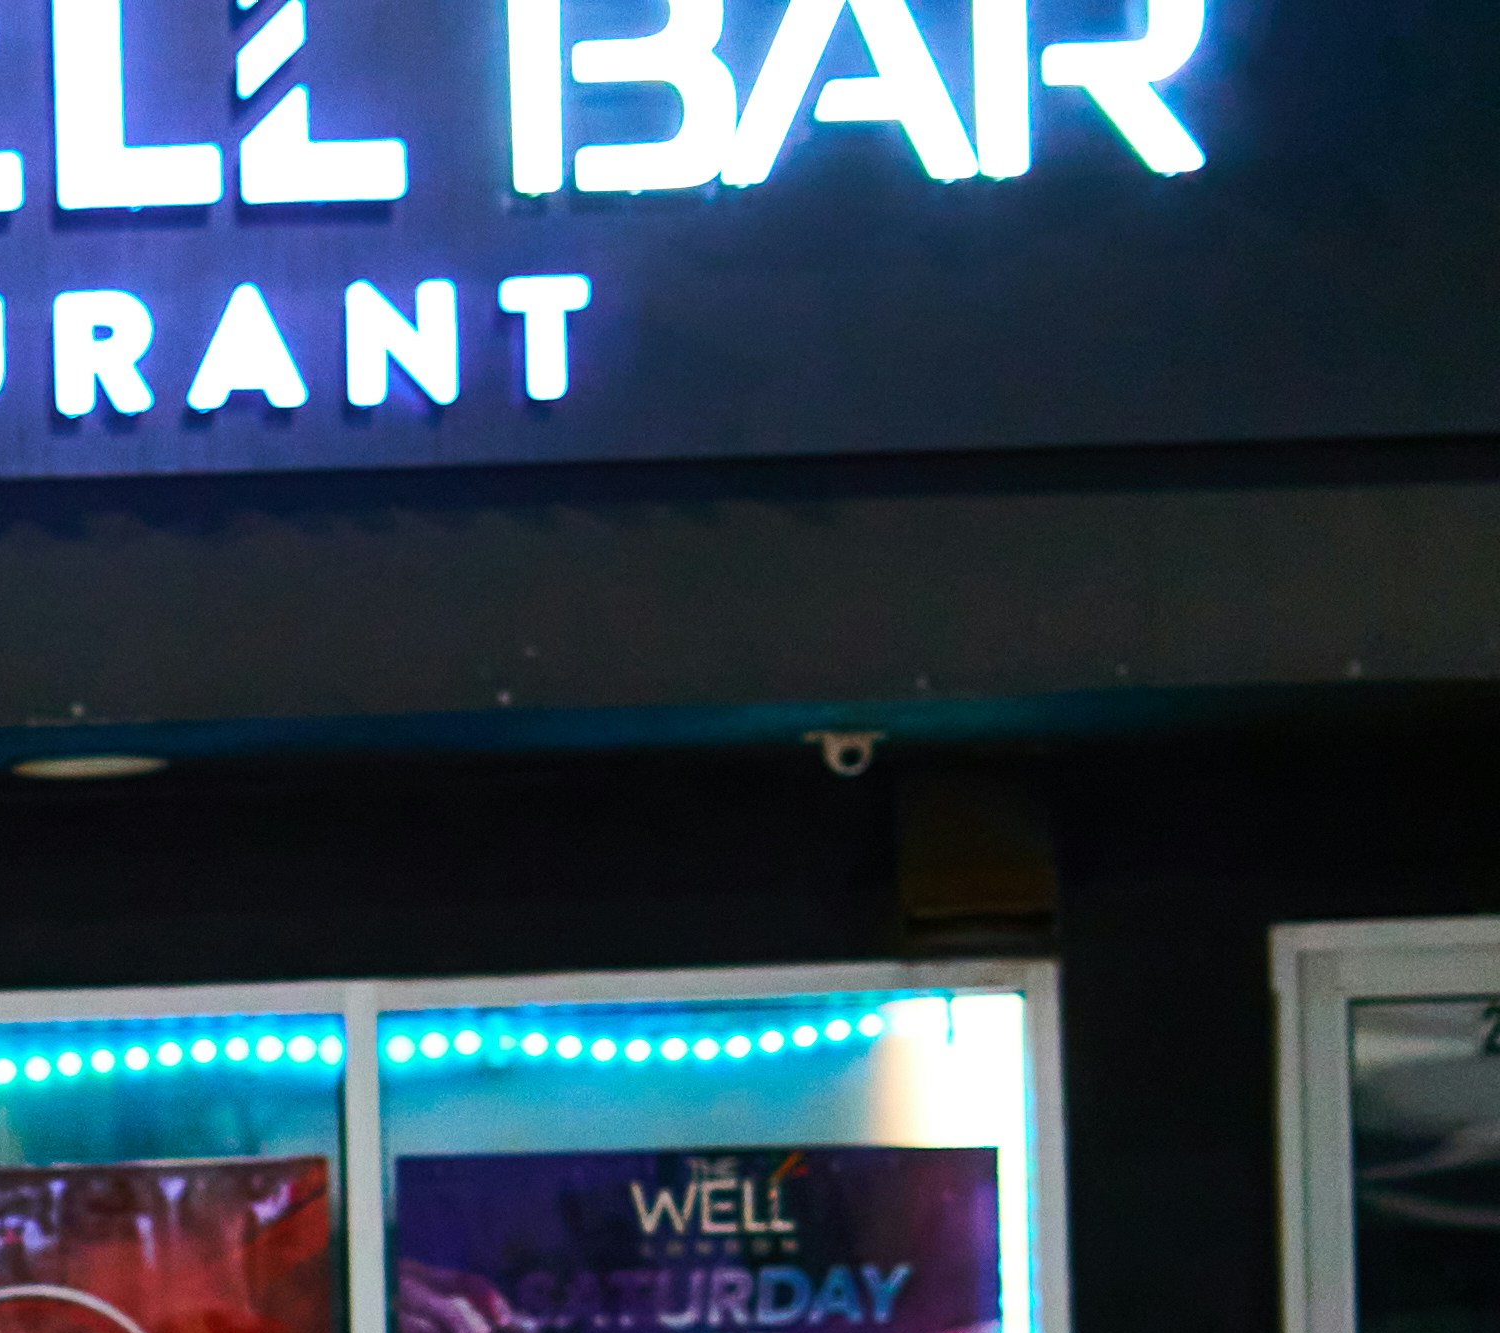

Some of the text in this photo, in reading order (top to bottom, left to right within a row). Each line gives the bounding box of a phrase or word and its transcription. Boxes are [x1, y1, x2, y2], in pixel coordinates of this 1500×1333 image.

[508, 0, 1206, 196] BAR
[630, 1178, 796, 1235] WELL
[515, 1262, 912, 1327] SATURDAY
